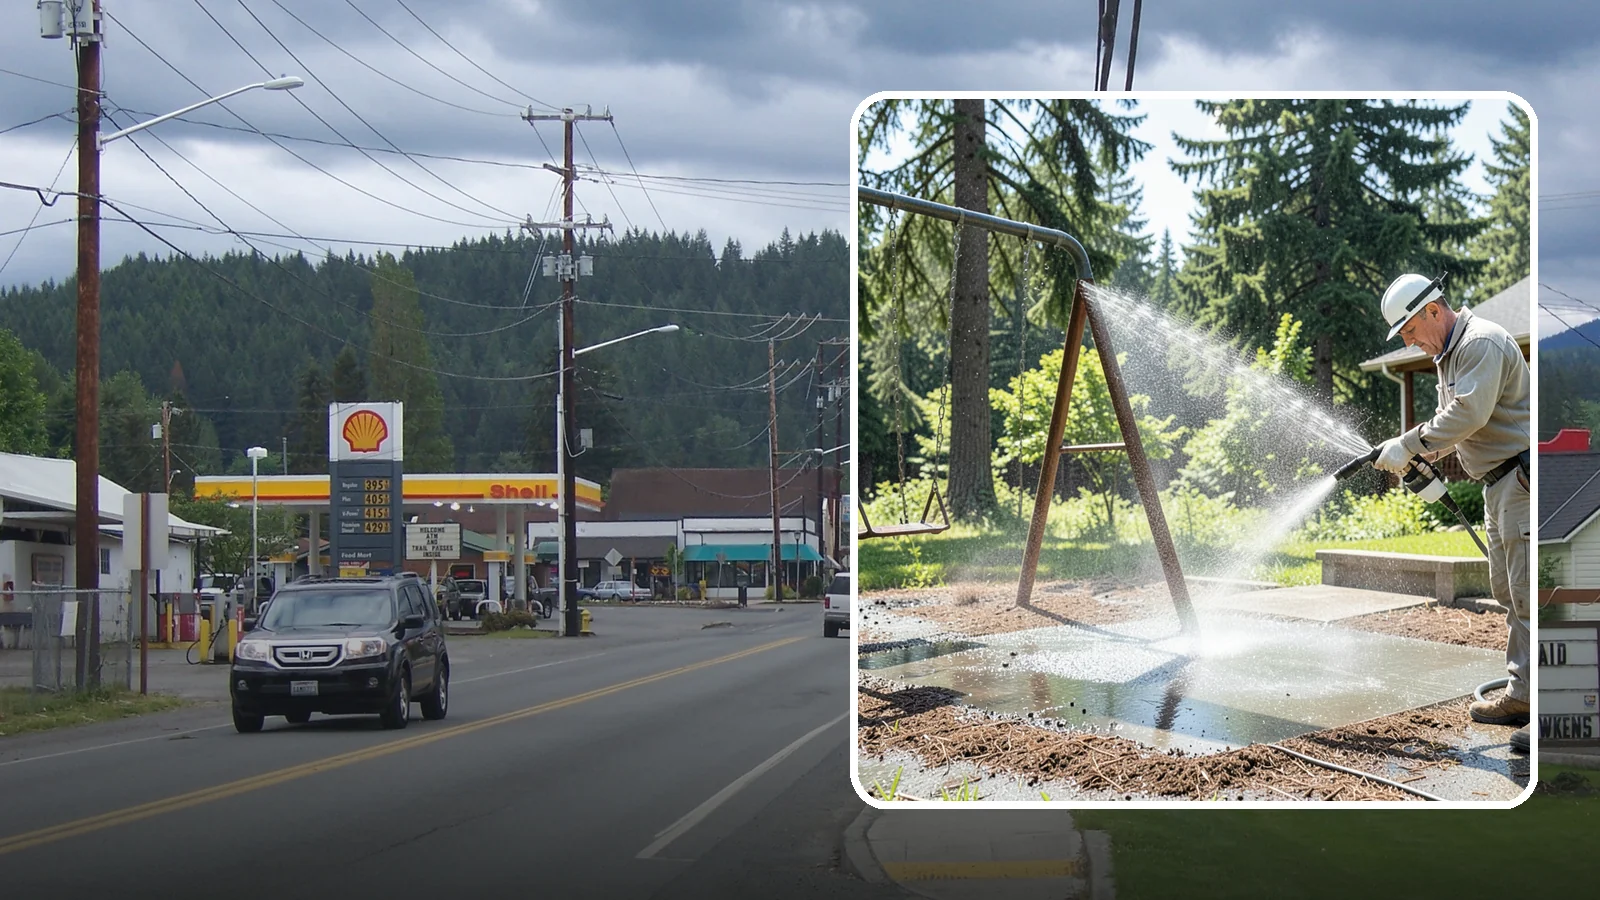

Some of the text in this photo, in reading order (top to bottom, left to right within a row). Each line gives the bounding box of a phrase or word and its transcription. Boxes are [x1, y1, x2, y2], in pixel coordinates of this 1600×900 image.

[366, 480, 383, 490] 395
[490, 484, 547, 499] Shell
[366, 494, 383, 504] 405
[366, 508, 383, 518] 415
[366, 522, 383, 532] 429
[1539, 643, 1566, 665] AID
